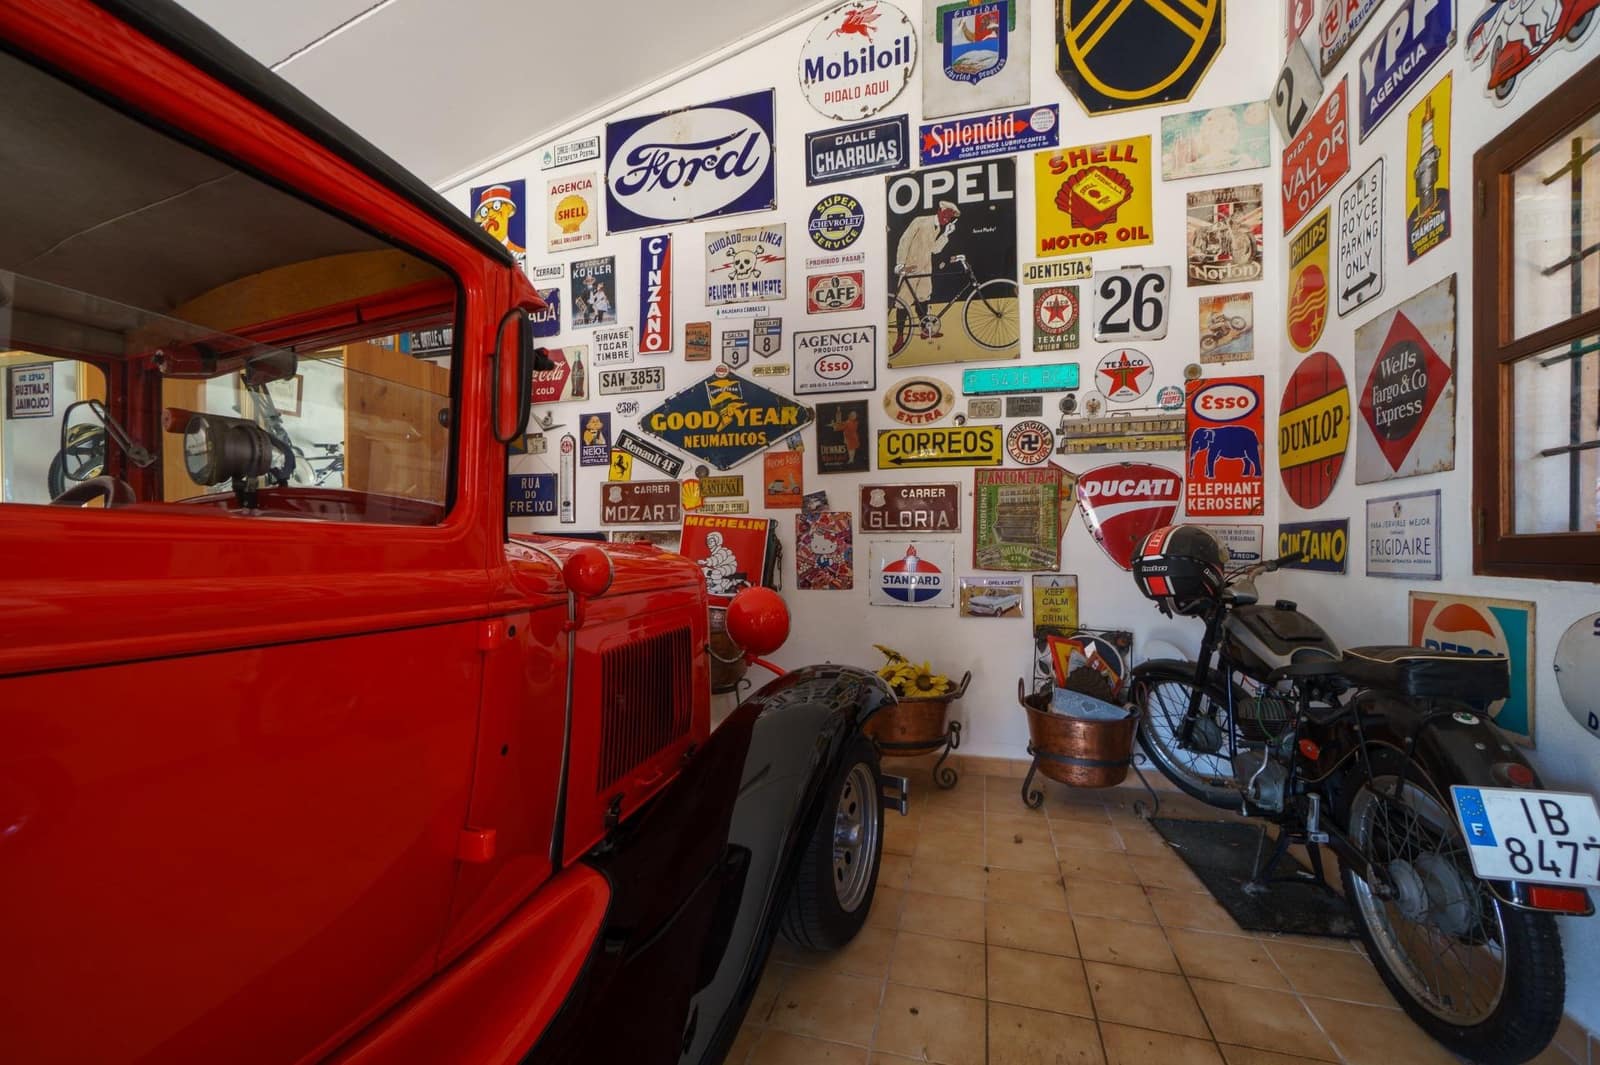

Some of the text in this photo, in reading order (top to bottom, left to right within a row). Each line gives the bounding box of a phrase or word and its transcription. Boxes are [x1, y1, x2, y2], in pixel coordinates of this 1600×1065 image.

[954, 4, 998, 19] Florida
[805, 36, 910, 82] Mobiloil
[1370, 43, 1427, 115] AGENCIA
[824, 80, 890, 104] PIDALO AQUI
[835, 130, 876, 146] CALLE
[930, 113, 1015, 158] Splendid
[961, 146, 974, 154] SON
[976, 142, 999, 150] BUENOS
[1001, 136, 1046, 148] LUBRIFICANTES
[615, 128, 761, 197] Ford
[816, 140, 898, 172] CHARRUAS
[1049, 143, 1138, 175] SHELL
[1284, 120, 1346, 202] VALOR
[551, 179, 592, 195] AGENCIA
[888, 164, 1014, 215] OPEL
[1298, 174, 1328, 212] OIL
[1343, 174, 1378, 218] ROLLS
[558, 206, 586, 221] SHELL
[817, 196, 857, 214] SUPER
[812, 217, 860, 228] CHEVROLET
[1342, 196, 1378, 240] ROYCE
[1411, 210, 1446, 244] CHAMPION
[708, 233, 741, 254] CUIDADO
[758, 231, 783, 248] LINEA
[812, 228, 858, 249] SERVICE
[1042, 226, 1149, 252] MOTOR OIL
[1291, 218, 1327, 264] PHILIPS
[1340, 220, 1379, 262] PARKING
[536, 266, 561, 277] CERRADO
[573, 265, 612, 279] KOHLER
[1030, 261, 1084, 280] DENTISTA
[1194, 262, 1254, 280] Norton
[1345, 248, 1373, 280] ONLY
[645, 238, 663, 351] CINZANO
[708, 280, 782, 302] PELIGRO DE MUERTE
[816, 287, 855, 303] CAFE
[1100, 273, 1165, 334] 26
[596, 331, 629, 342] SIRVASE
[598, 340, 628, 351] TOCAR
[763, 337, 771, 352] 8
[798, 331, 870, 350] AGENCIA
[1038, 334, 1076, 344] TEXACO
[597, 350, 629, 362] TIMBRE
[732, 351, 740, 364] 9
[814, 346, 853, 354] PRODUCTOS
[1104, 360, 1144, 368] TEXACO
[1380, 350, 1417, 379] Wells
[631, 369, 661, 386] 3853
[536, 387, 555, 396] COLD
[651, 411, 719, 432] GOOD
[896, 410, 944, 424] EXTRA
[1375, 399, 1423, 427] Express
[1010, 422, 1050, 440] ENERGINA
[1281, 405, 1344, 456] DUNLOP
[684, 432, 767, 448] NEUMATICOS
[886, 431, 994, 455] CORREOS
[622, 438, 676, 472] Renault 4F
[521, 478, 540, 489] RUA
[634, 484, 670, 494] CARRER
[1084, 479, 1175, 498] DUCATI
[1188, 482, 1261, 496] ELEPHANT
[525, 490, 537, 499] DO
[901, 489, 946, 498] CARRER
[510, 501, 553, 512] FREIXO
[1188, 496, 1262, 511] KEROSENE
[605, 505, 677, 521] MOZART
[870, 511, 950, 528] GLORIA
[1409, 518, 1431, 526] MEJOR
[685, 517, 766, 531] MICHELIN
[1279, 529, 1346, 564] CINZANO
[1370, 537, 1432, 556] FRIGIDAIRE
[883, 575, 940, 586] STANDARD
[1045, 588, 1065, 596] KEEP
[1042, 598, 1068, 606] CALM
[1042, 614, 1070, 622] DRINK
[1519, 798, 1570, 836] IB
[1471, 822, 1486, 837] E
